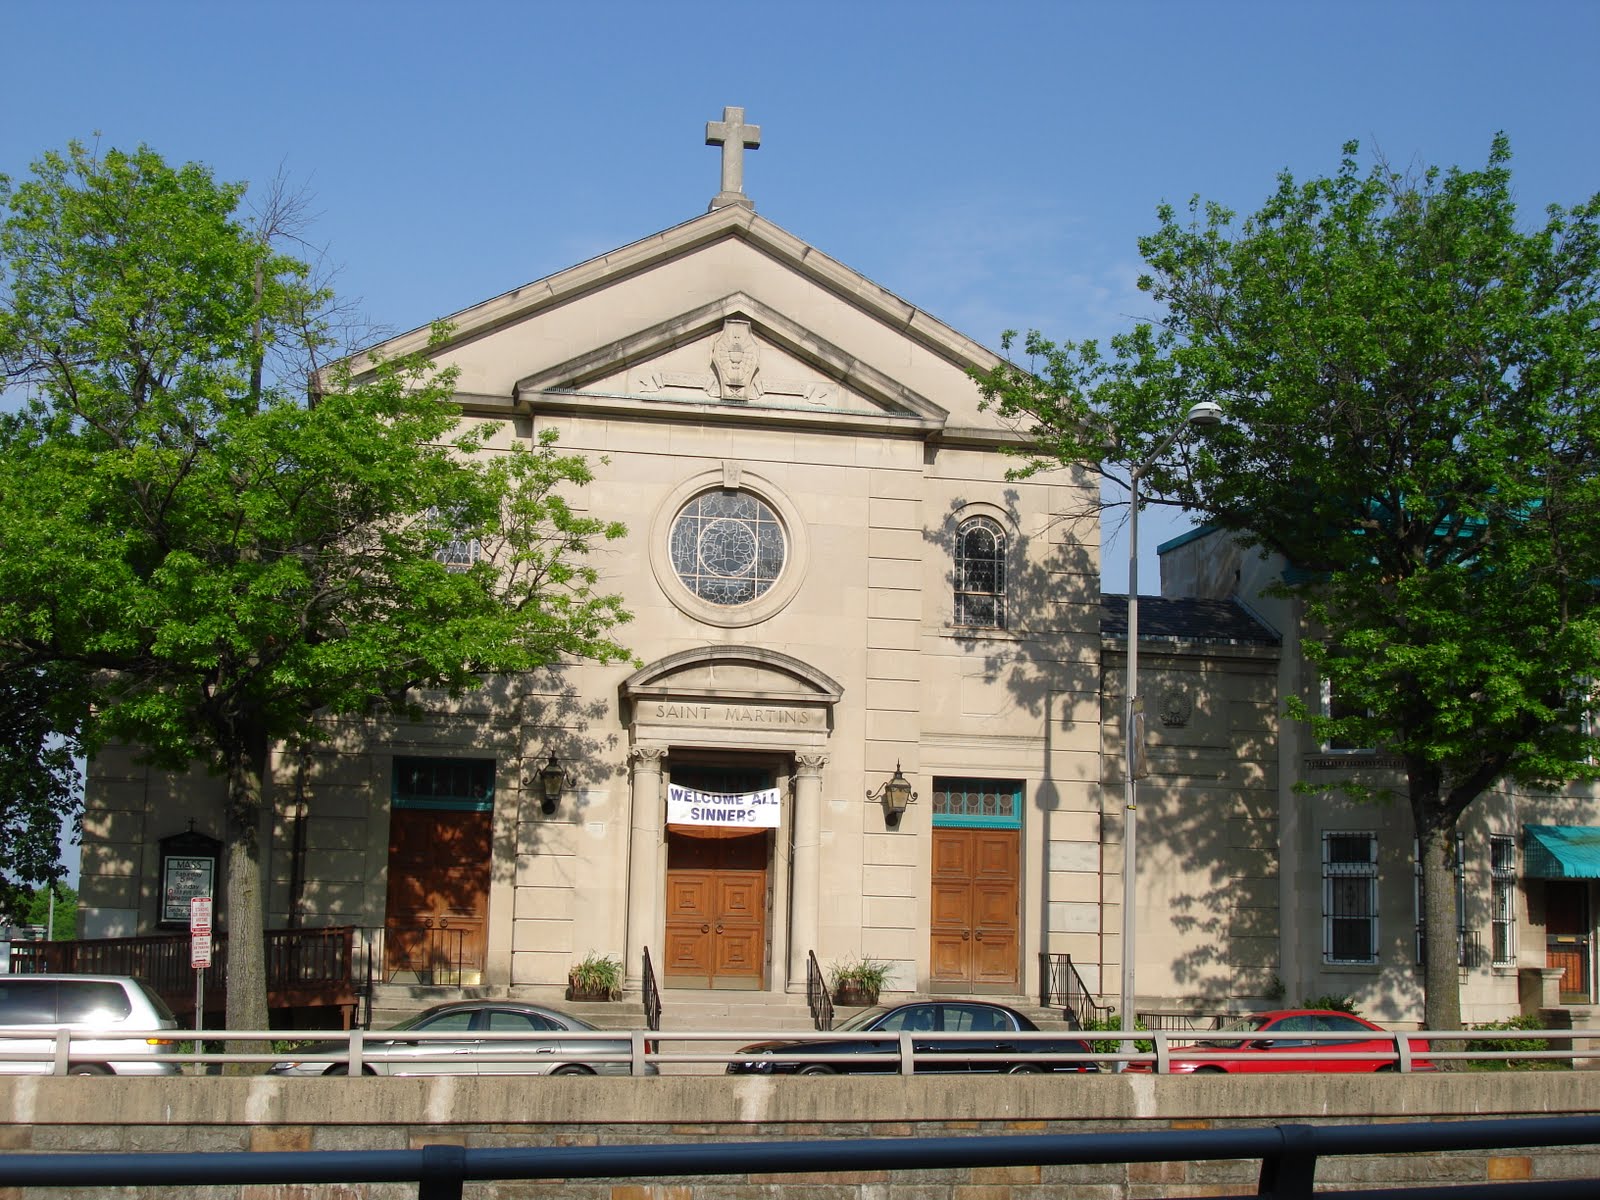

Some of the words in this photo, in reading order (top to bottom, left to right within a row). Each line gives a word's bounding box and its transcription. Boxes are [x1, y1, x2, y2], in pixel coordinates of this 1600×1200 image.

[656, 705, 711, 719] SAINT
[725, 708, 809, 724] MARTINS
[670, 788, 744, 805] WELCOME
[751, 792, 779, 805] ALL
[690, 807, 757, 822] SINNERS
[177, 861, 202, 869] MASS
[176, 882, 200, 890] Sunday
